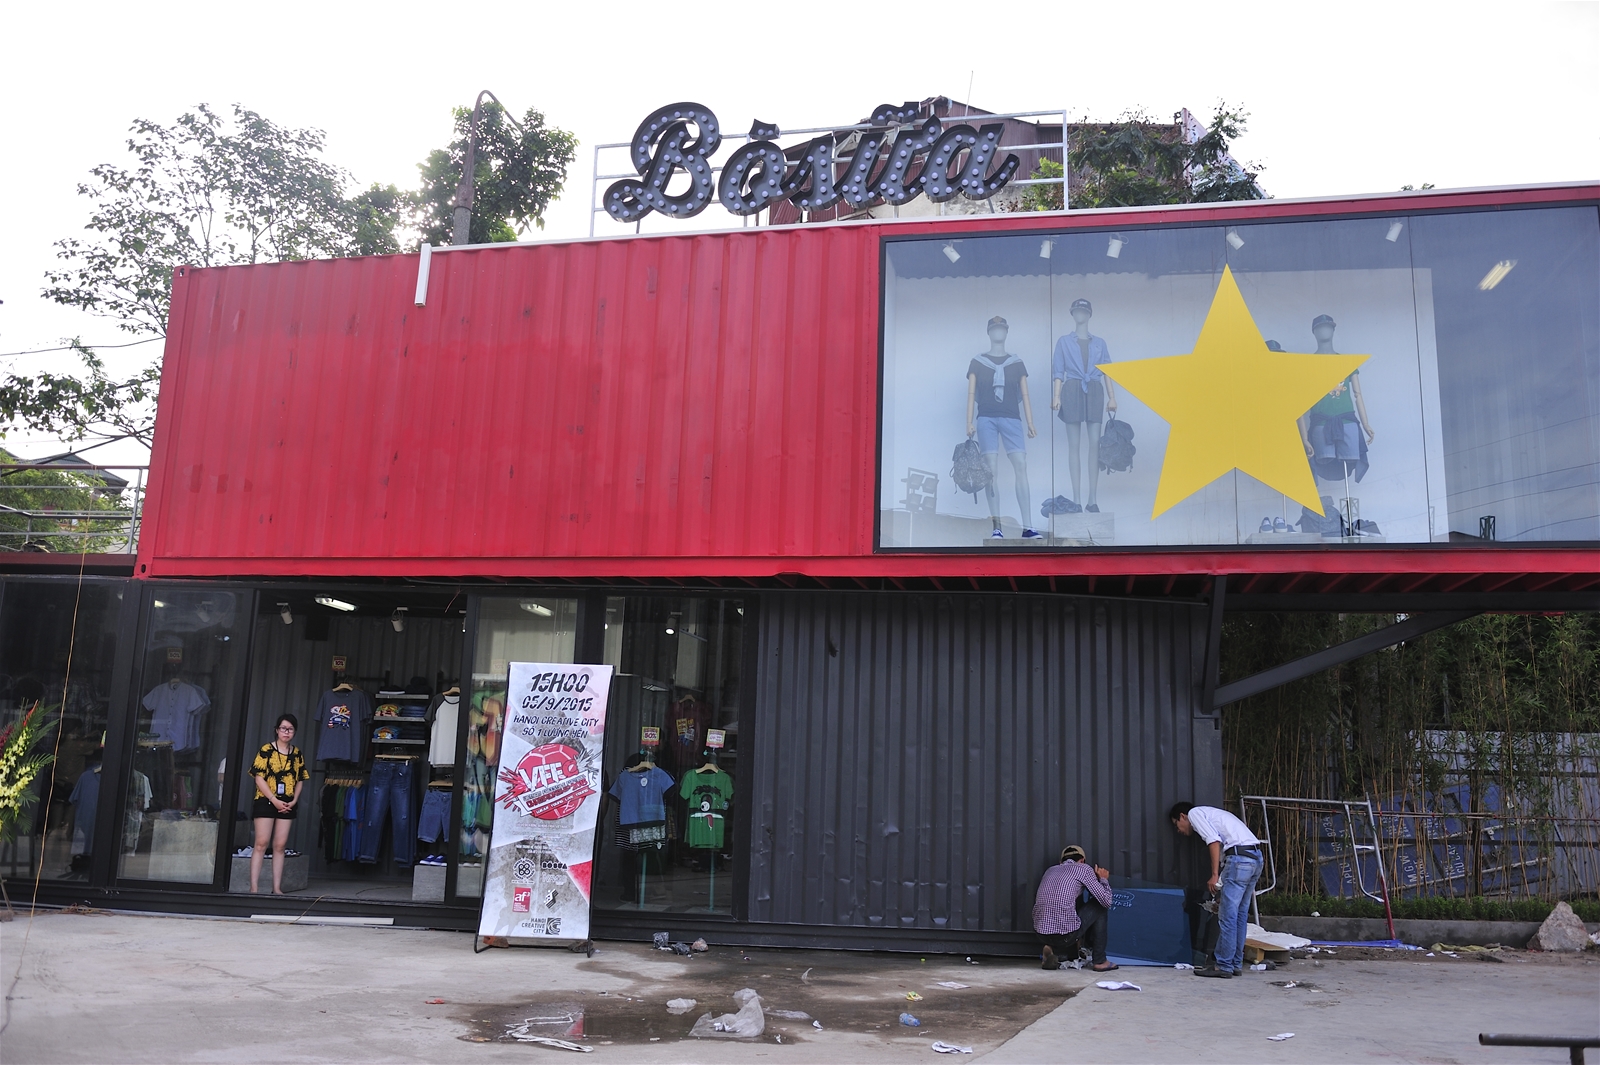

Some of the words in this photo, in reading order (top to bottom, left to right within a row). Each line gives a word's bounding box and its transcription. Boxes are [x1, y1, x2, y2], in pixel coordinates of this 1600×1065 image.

[522, 695, 594, 712] 05/9/2015
[513, 714, 540, 725] HANOI
[541, 716, 580, 727] CREATIVE
[581, 717, 600, 727] CITY
[537, 728, 542, 737] 1
